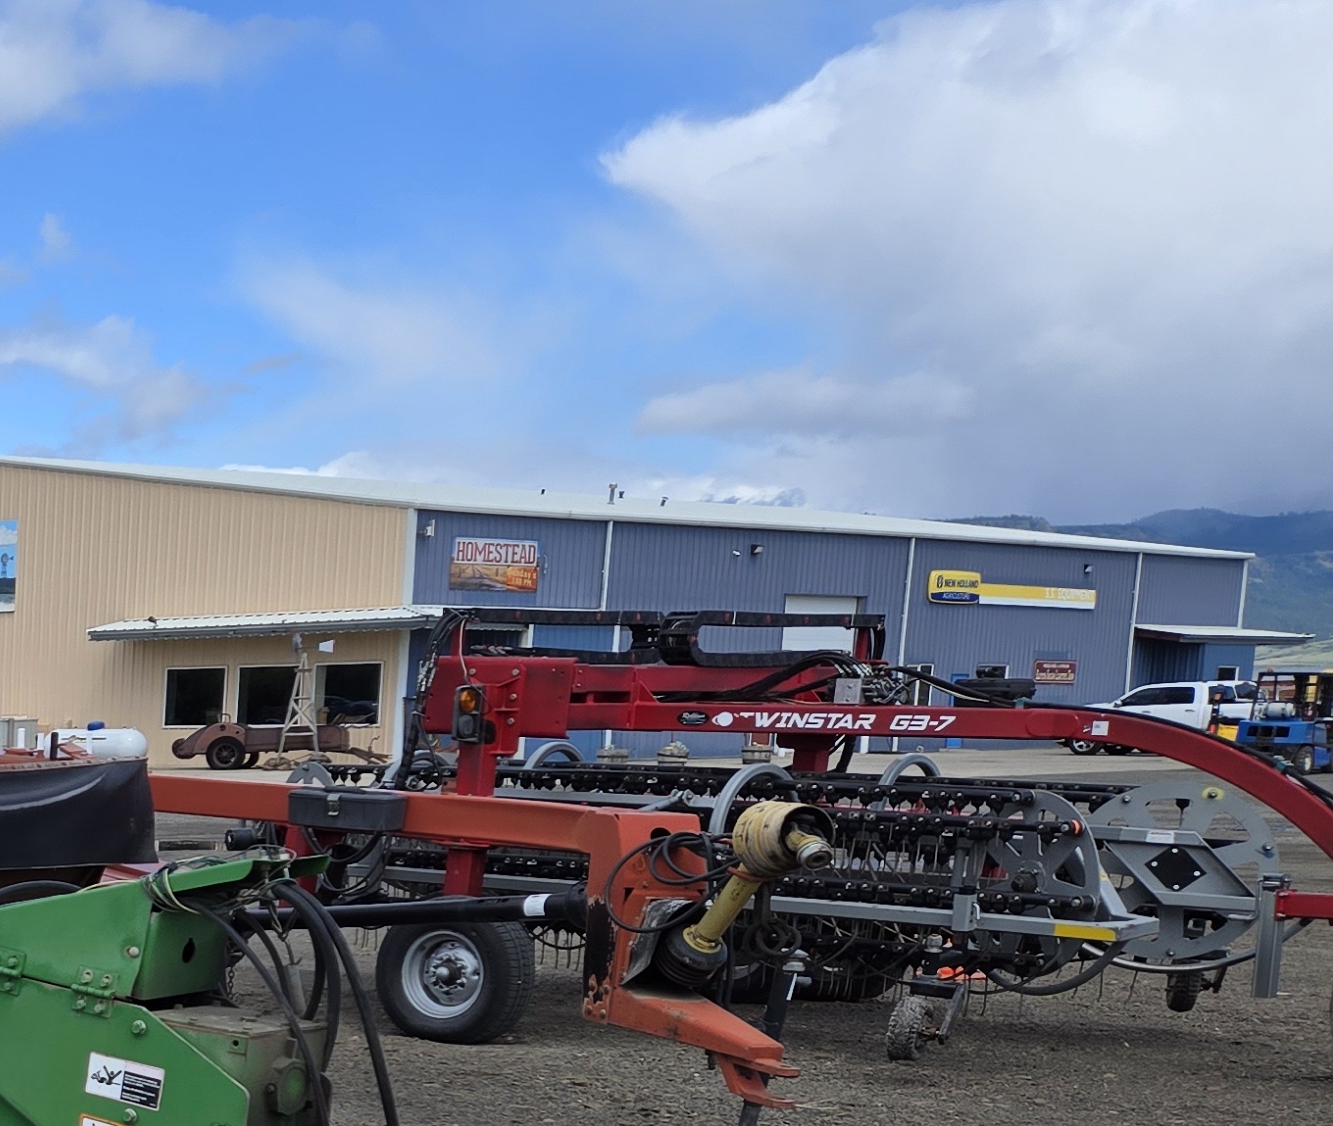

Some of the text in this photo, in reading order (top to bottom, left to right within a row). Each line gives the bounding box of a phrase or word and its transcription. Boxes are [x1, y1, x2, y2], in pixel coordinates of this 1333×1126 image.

[456, 541, 536, 565] HOMESTEAD
[740, 711, 956, 731] WINSTAR G3-7
